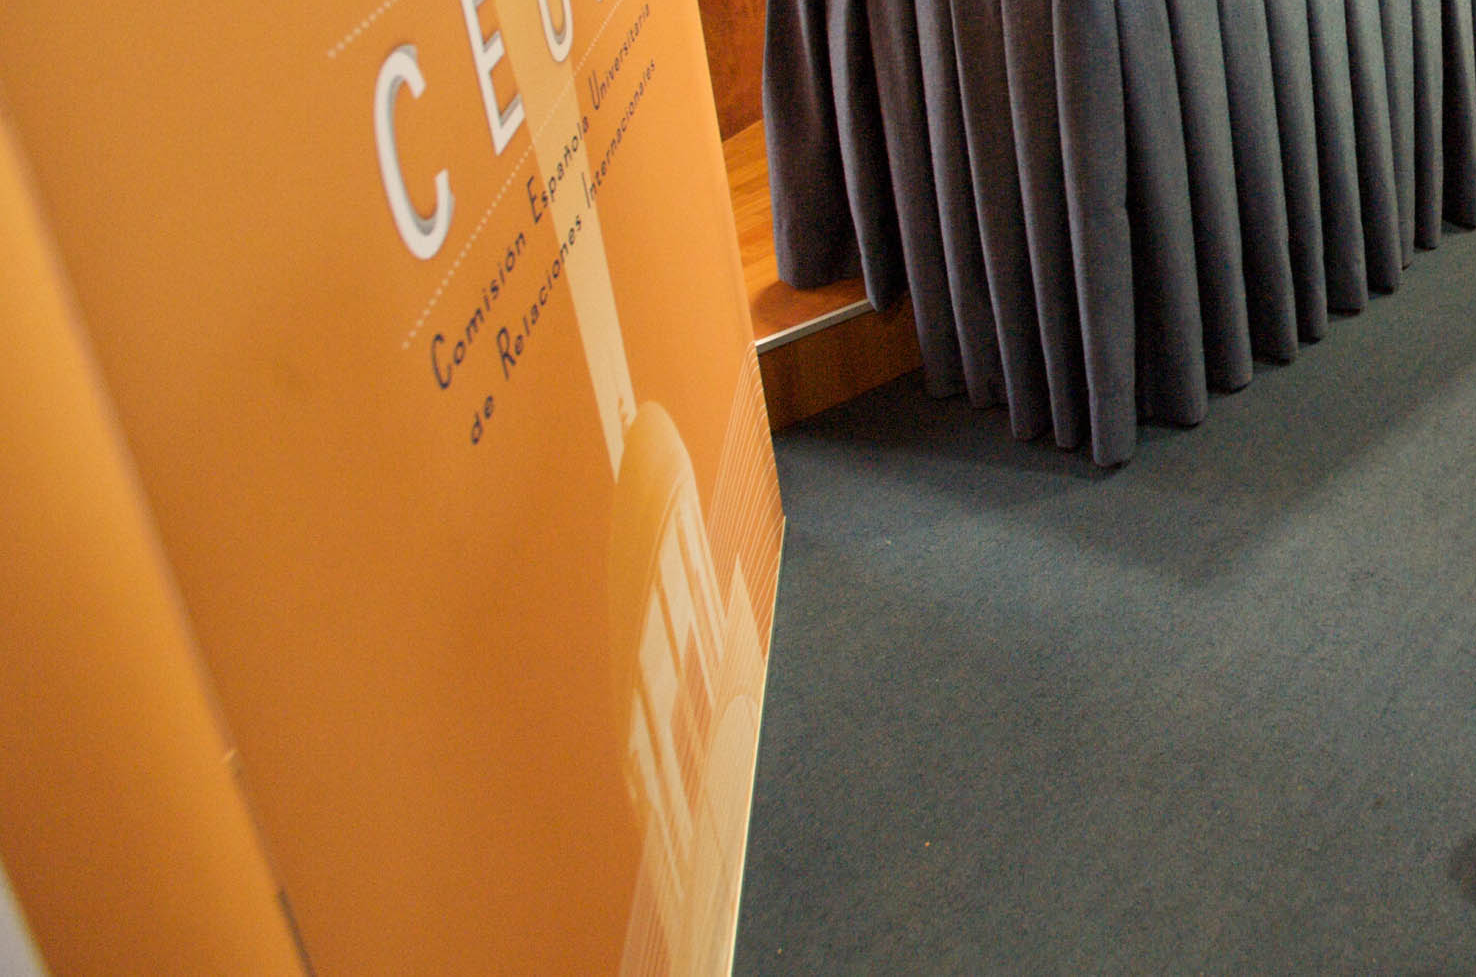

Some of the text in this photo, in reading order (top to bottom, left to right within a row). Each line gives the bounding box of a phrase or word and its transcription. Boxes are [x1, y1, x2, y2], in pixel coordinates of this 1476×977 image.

[431, 3, 650, 390] Comisión Española Universitaria
[470, 59, 656, 445] de Relaciones Internacionales
